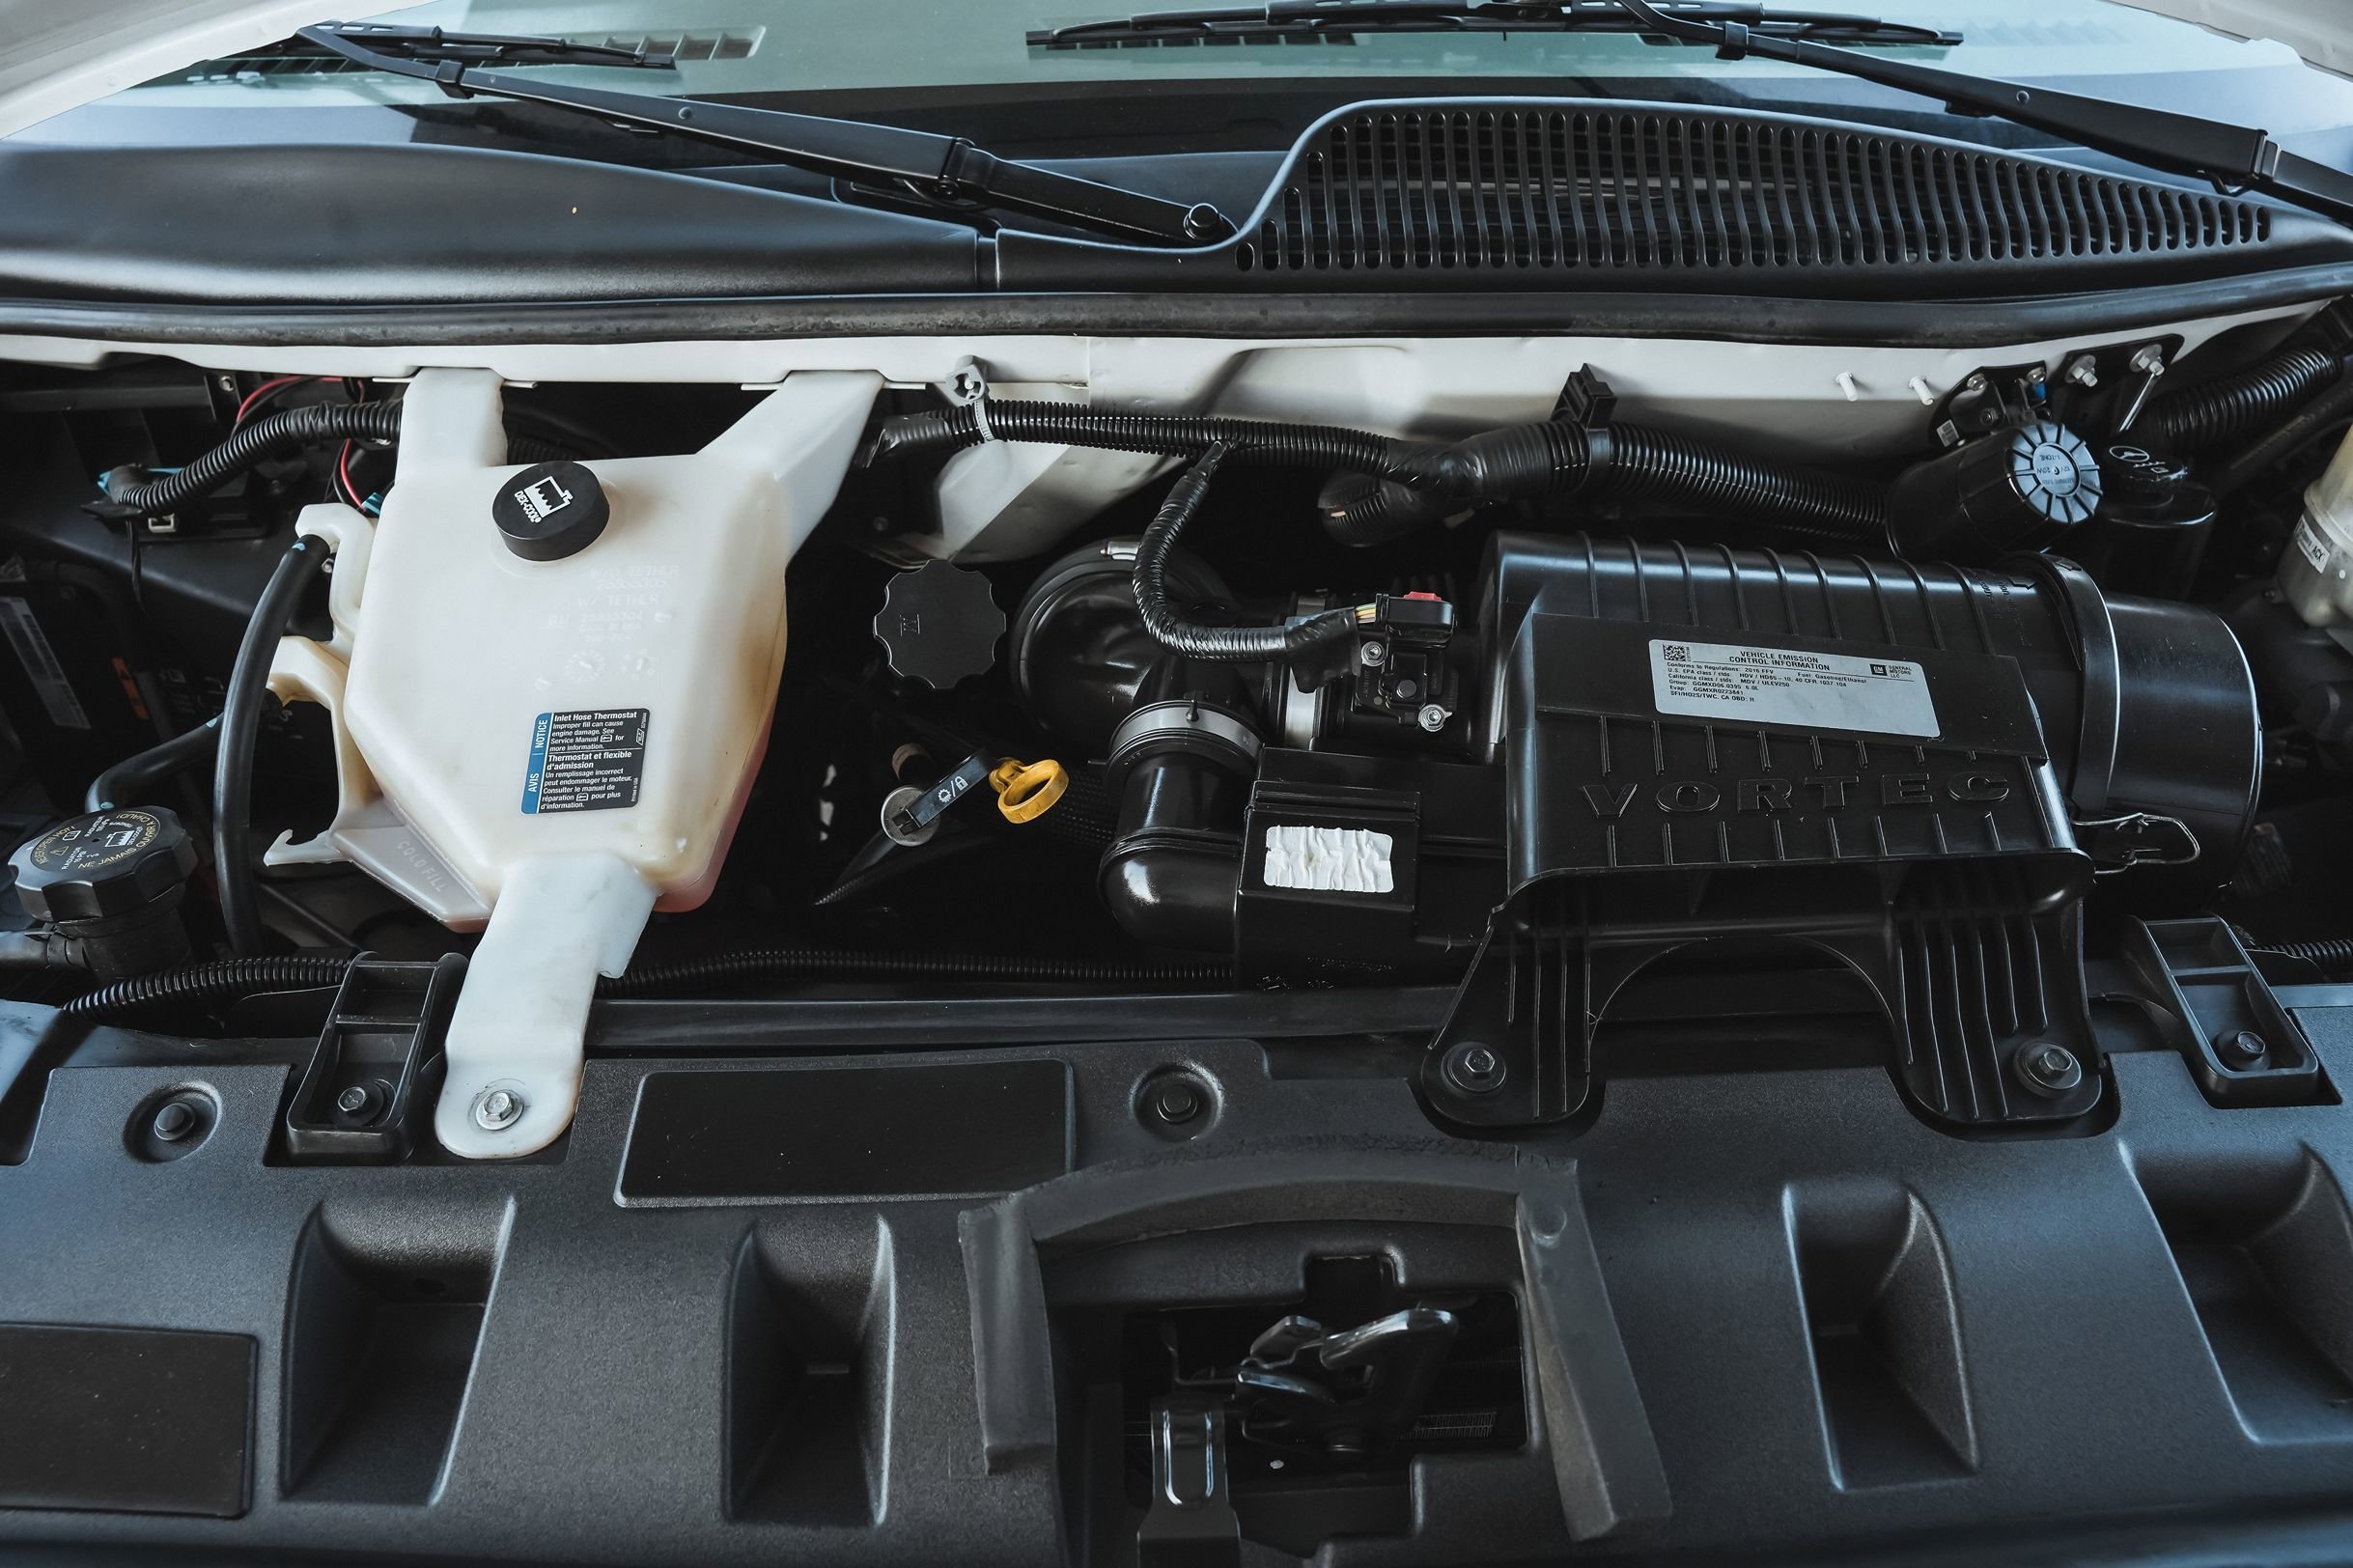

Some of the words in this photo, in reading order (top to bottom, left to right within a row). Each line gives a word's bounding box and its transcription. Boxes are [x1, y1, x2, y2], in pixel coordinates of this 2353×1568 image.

[1740, 651, 1775, 659] VEHICLE
[1778, 654, 1818, 664] EMISSION
[1730, 657, 1769, 665] CONTROL
[1772, 659, 1830, 671] INFORMATION
[594, 711, 637, 720] Thermostat
[535, 720, 548, 748] NOTICE
[548, 753, 592, 762] Thermostat
[603, 751, 632, 759] flexible
[547, 762, 594, 770] d'admission
[555, 770, 594, 778] remplissage
[528, 773, 539, 792] AVIS
[560, 777, 601, 786] endommager
[542, 794, 574, 802] réparation
[1583, 773, 2009, 818] VORTEC
[398, 841, 427, 868] COLD
[422, 867, 449, 892] FILL
